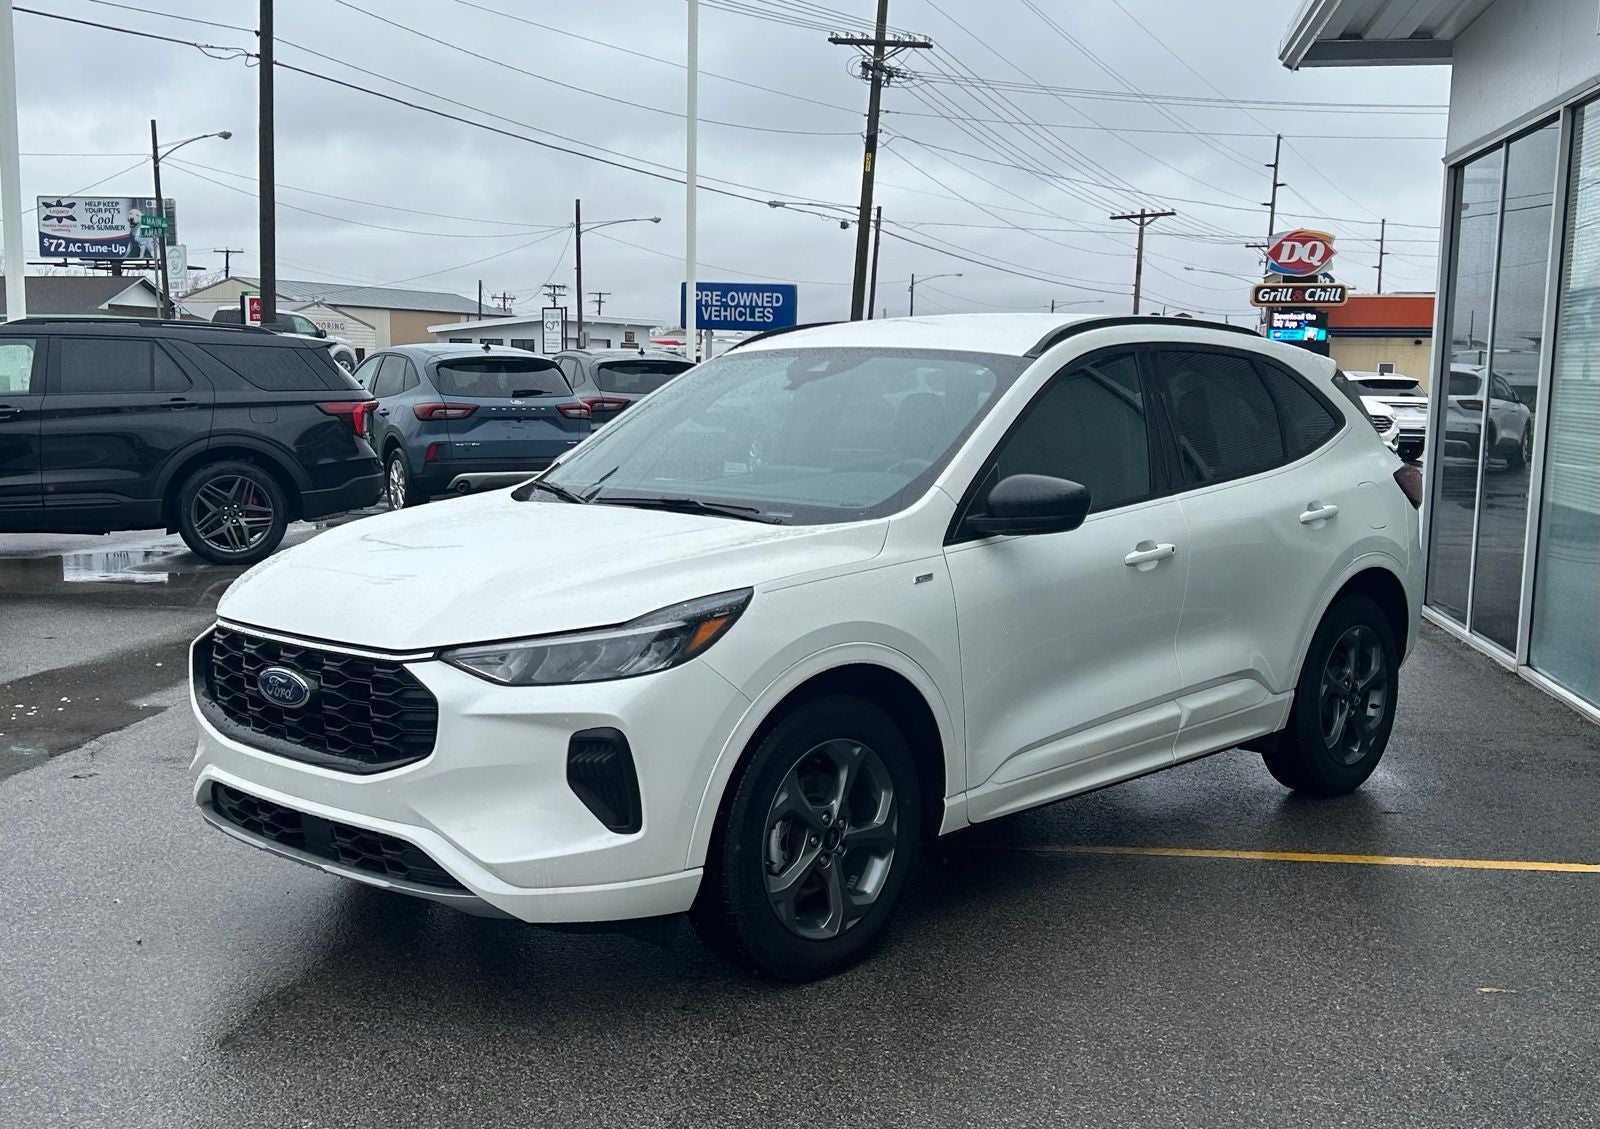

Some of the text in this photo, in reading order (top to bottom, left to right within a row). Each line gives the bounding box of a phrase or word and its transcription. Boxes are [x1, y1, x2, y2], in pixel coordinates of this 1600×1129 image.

[104, 207, 121, 215] PETS
[89, 213, 115, 225] Cool
[96, 224, 126, 232] SUMMER
[43, 237, 126, 255] $72 AC Tune-Up
[1278, 240, 1326, 266] DQ
[696, 291, 783, 307] PRE-OWNED
[1257, 287, 1342, 302] Grill & Chill
[701, 306, 774, 322] VEHICLES
[1305, 312, 1317, 321] the
[1285, 320, 1298, 328] App
